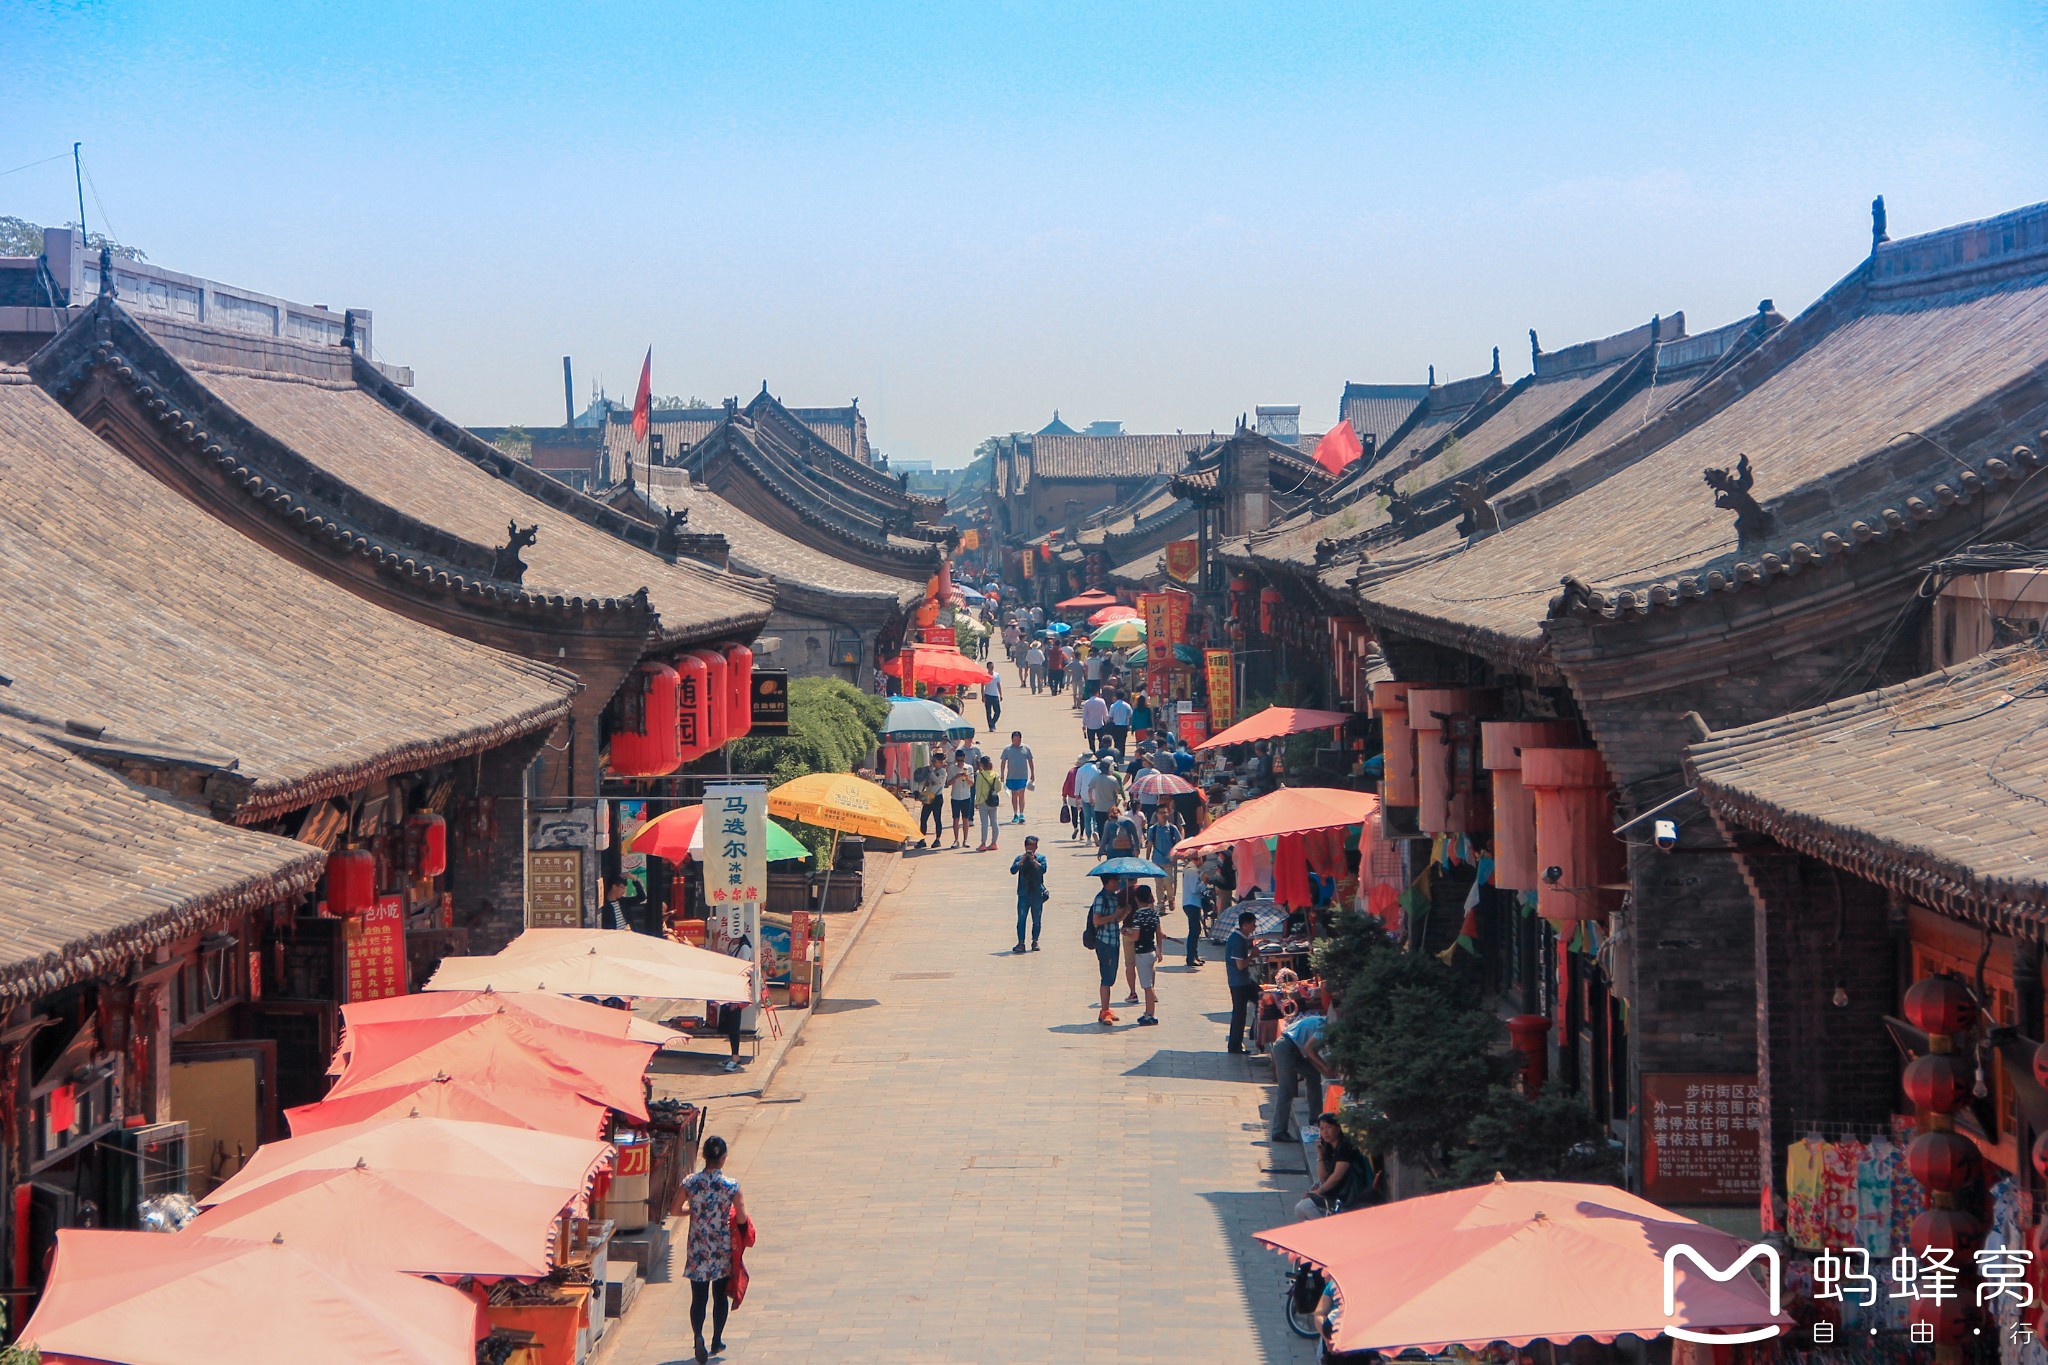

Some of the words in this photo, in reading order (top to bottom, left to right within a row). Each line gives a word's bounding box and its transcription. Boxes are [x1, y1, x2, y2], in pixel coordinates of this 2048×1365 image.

[722, 796, 748, 858] 马迭尔
[713, 886, 758, 901] 哈尔滨
[732, 906, 740, 936] 1906
[1686, 1084, 1759, 1099] 步行街区及
[1653, 1101, 1760, 1115] 外一百米范围内
[1653, 1117, 1760, 1131] 禁停放任何车辆
